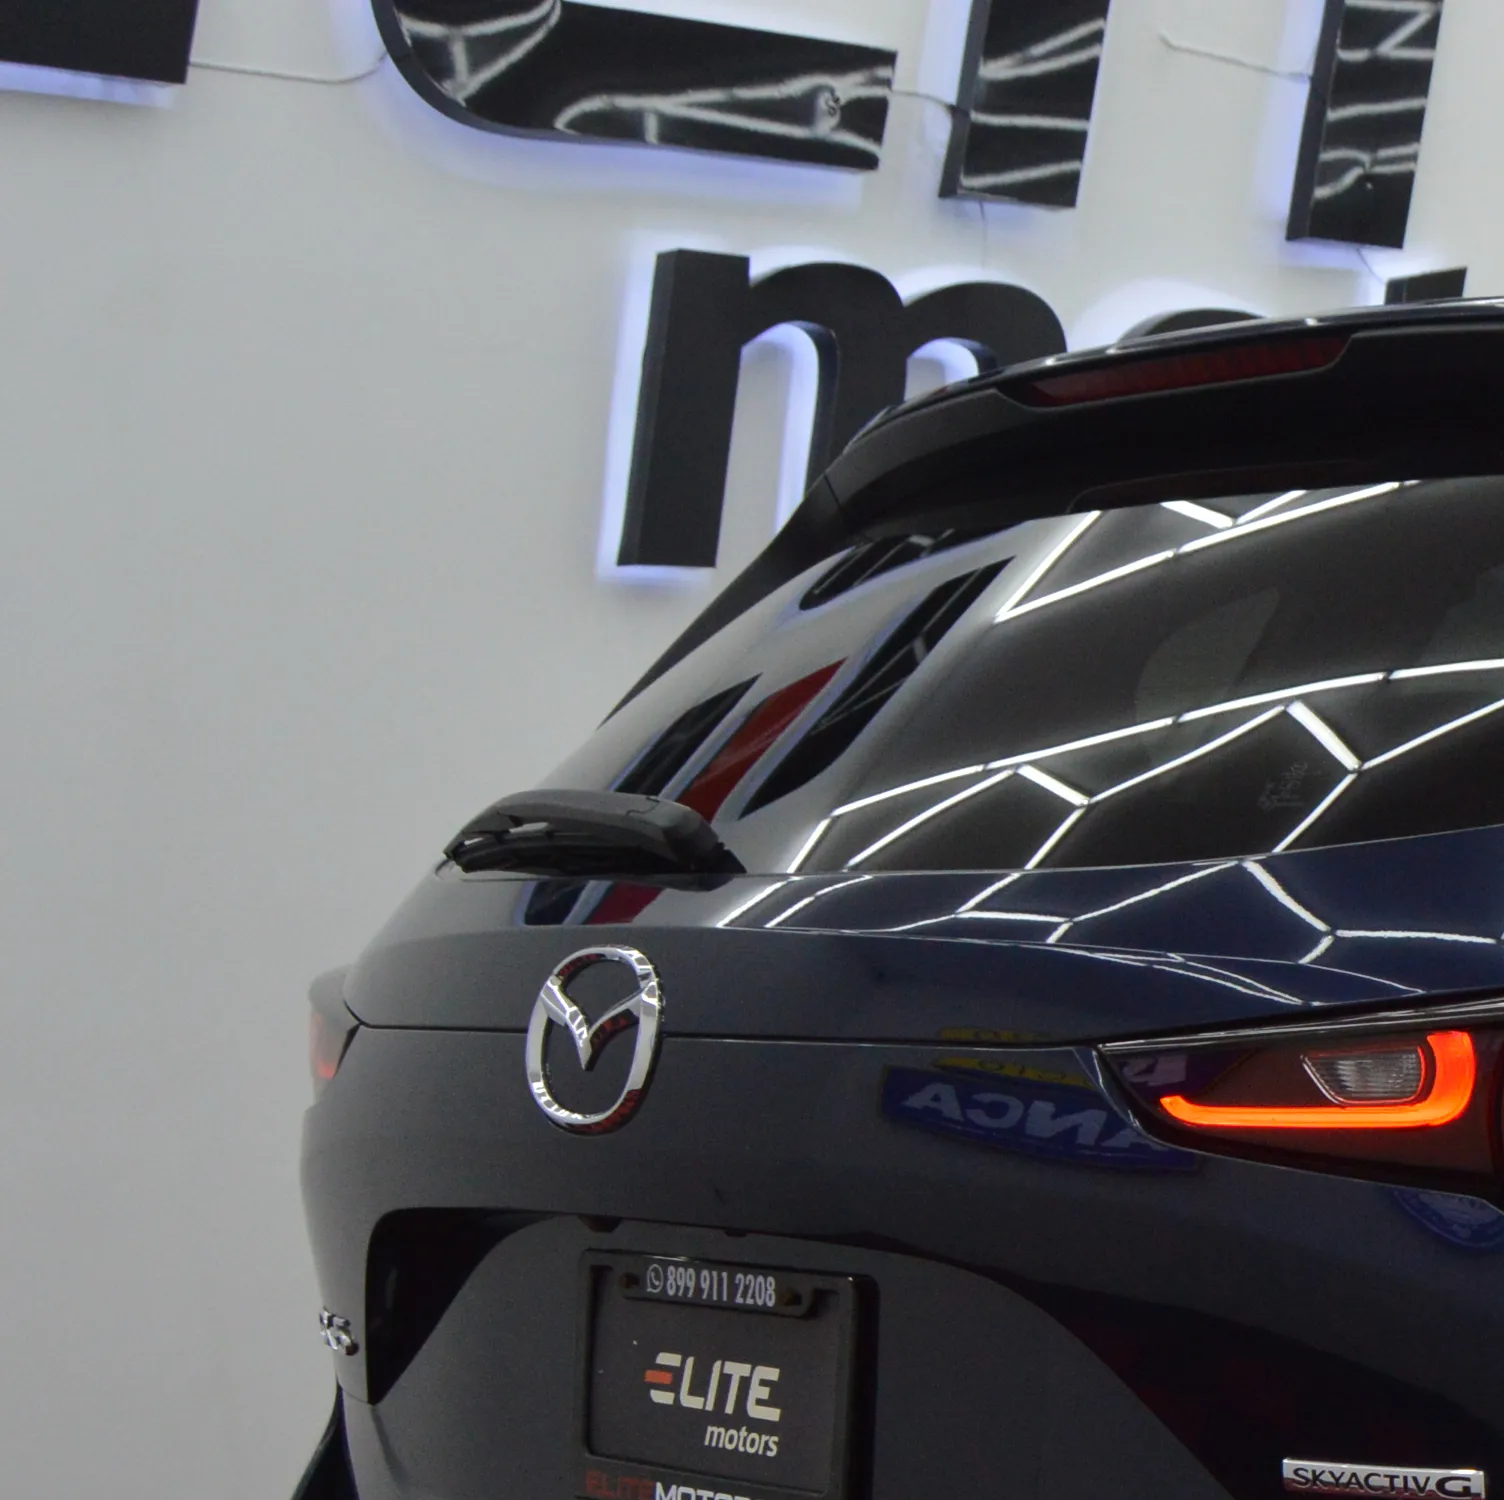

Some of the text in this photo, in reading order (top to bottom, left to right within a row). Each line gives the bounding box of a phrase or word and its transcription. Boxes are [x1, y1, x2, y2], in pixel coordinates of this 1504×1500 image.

[666, 1265, 777, 1307] 899 911 2208
[644, 1352, 782, 1422] ELITE
[704, 1425, 779, 1457] motors
